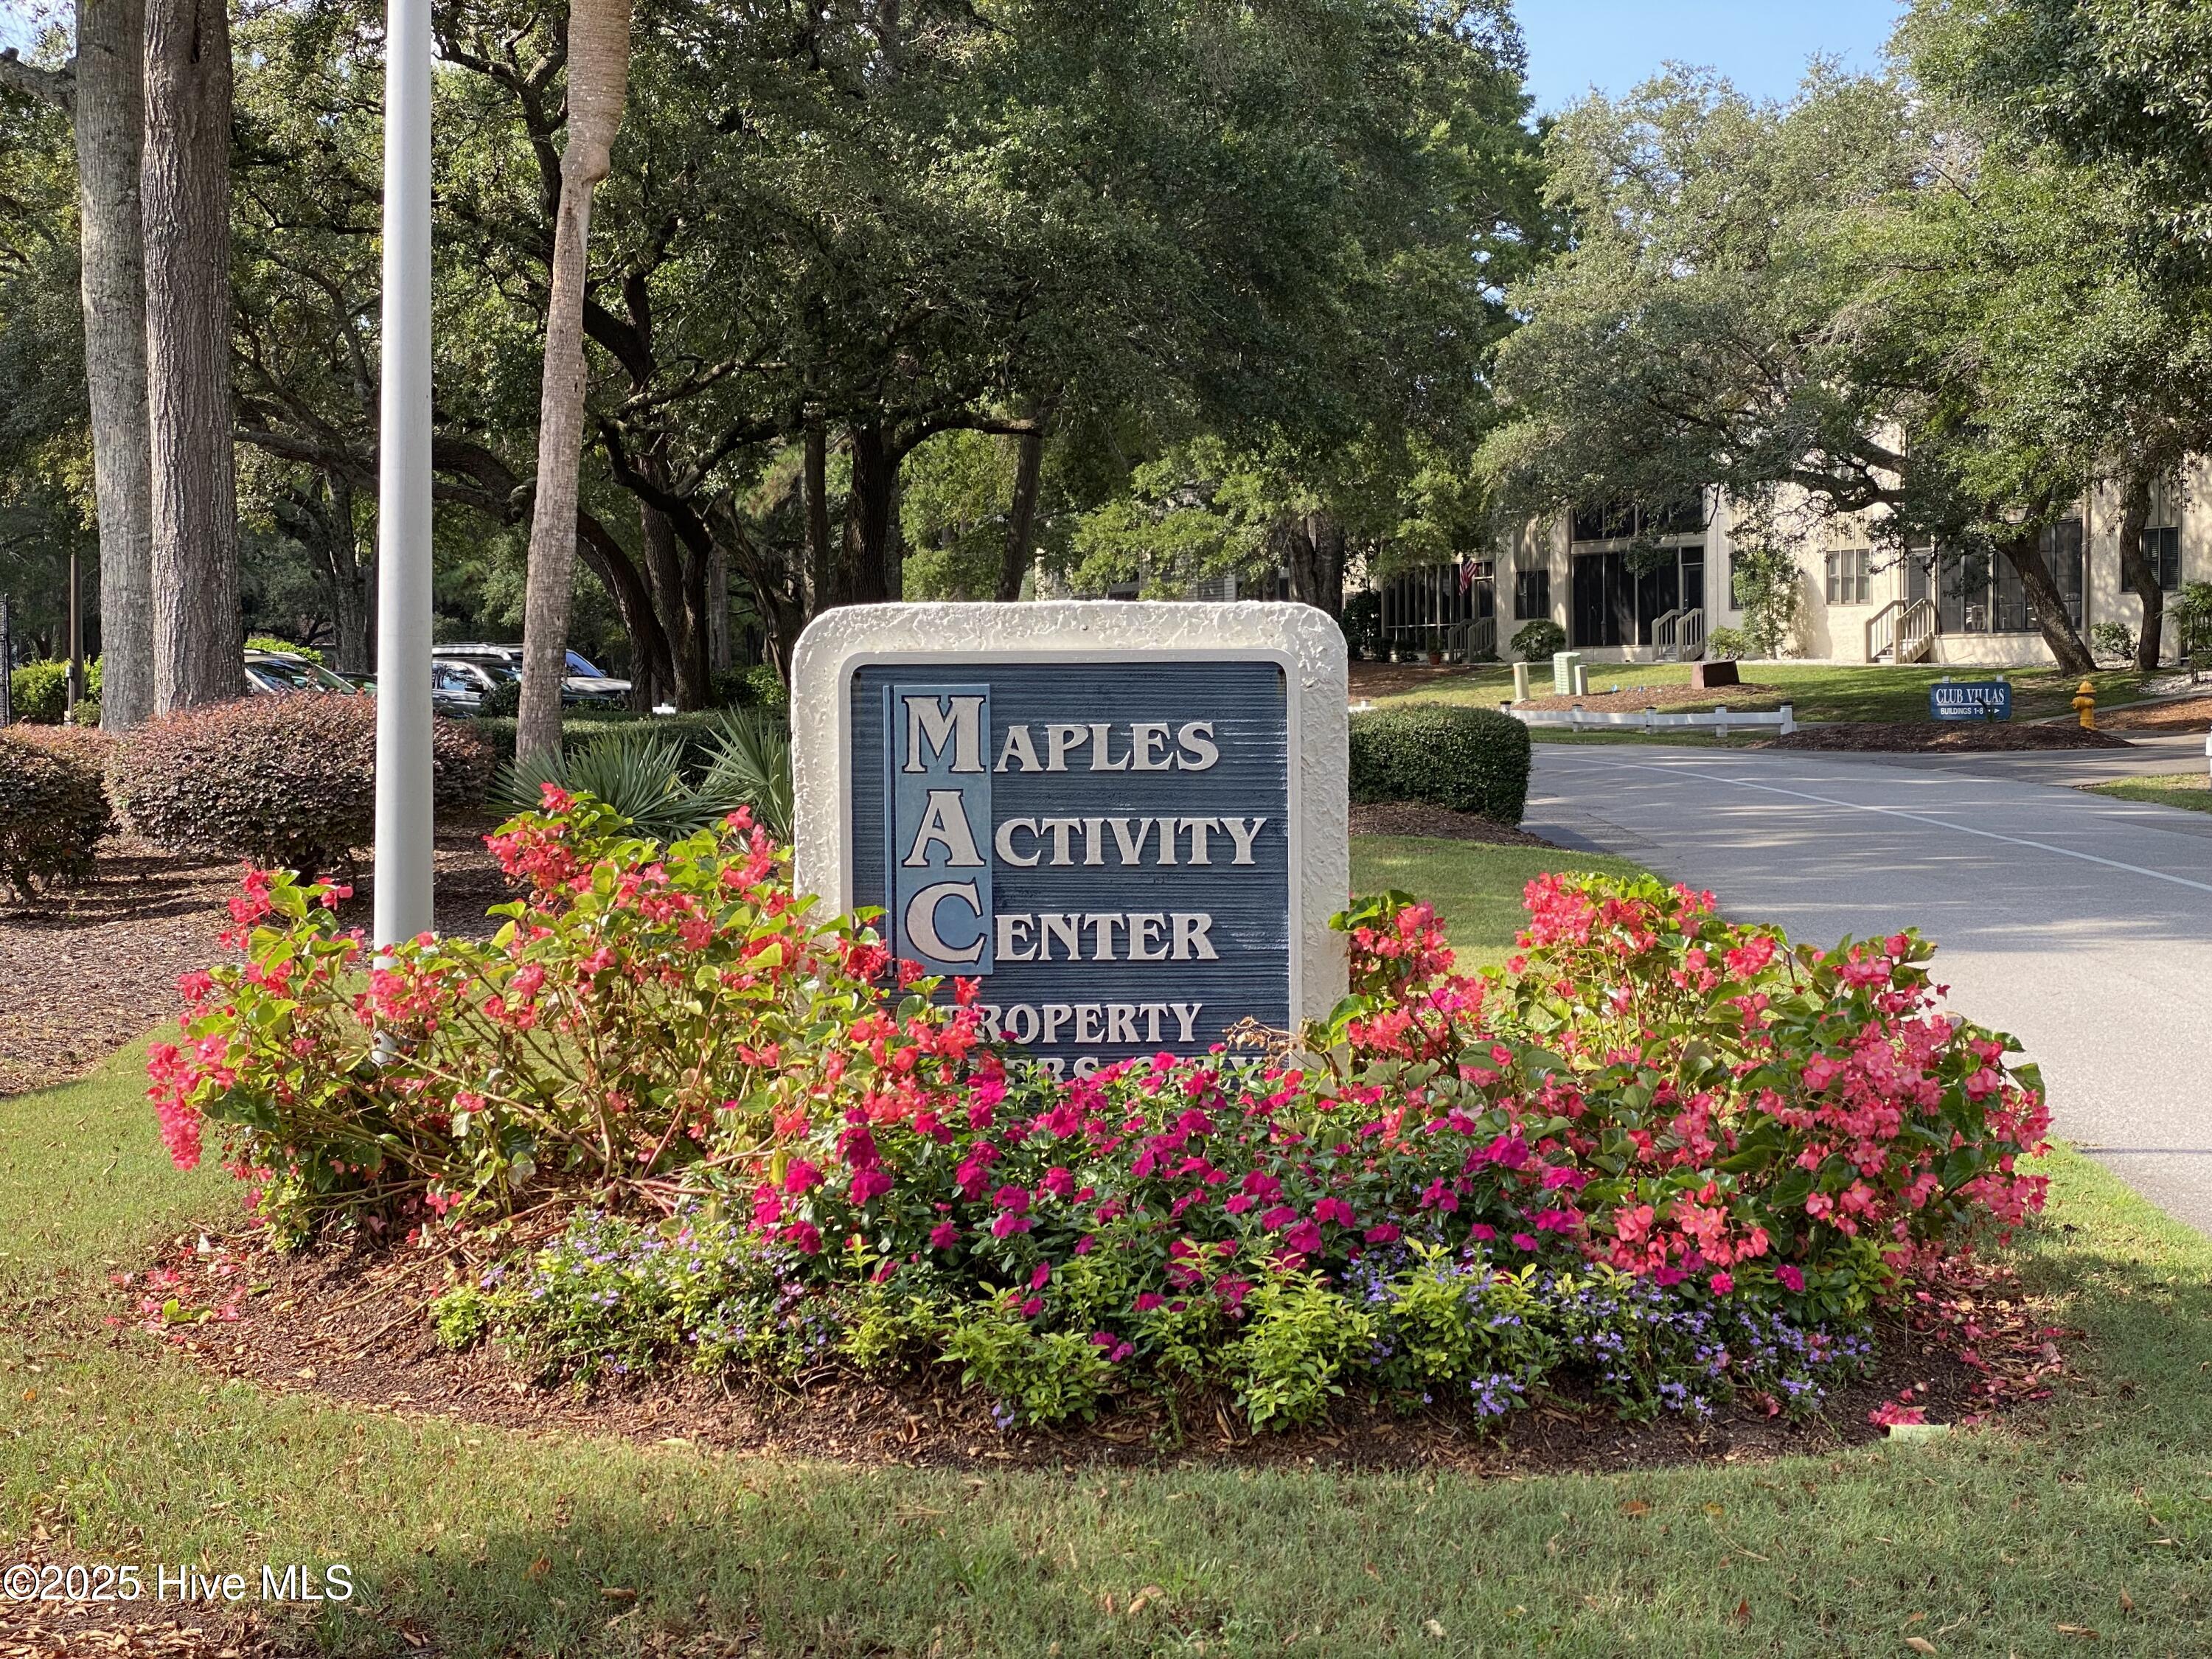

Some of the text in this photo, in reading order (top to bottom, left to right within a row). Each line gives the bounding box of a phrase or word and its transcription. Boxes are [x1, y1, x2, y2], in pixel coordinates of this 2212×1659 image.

[902, 695, 1219, 773] MAPLES
[1936, 688, 2004, 703] CLUB VILLAS
[902, 789, 1267, 867] ACTIVITY
[905, 877, 1219, 963] CENTER
